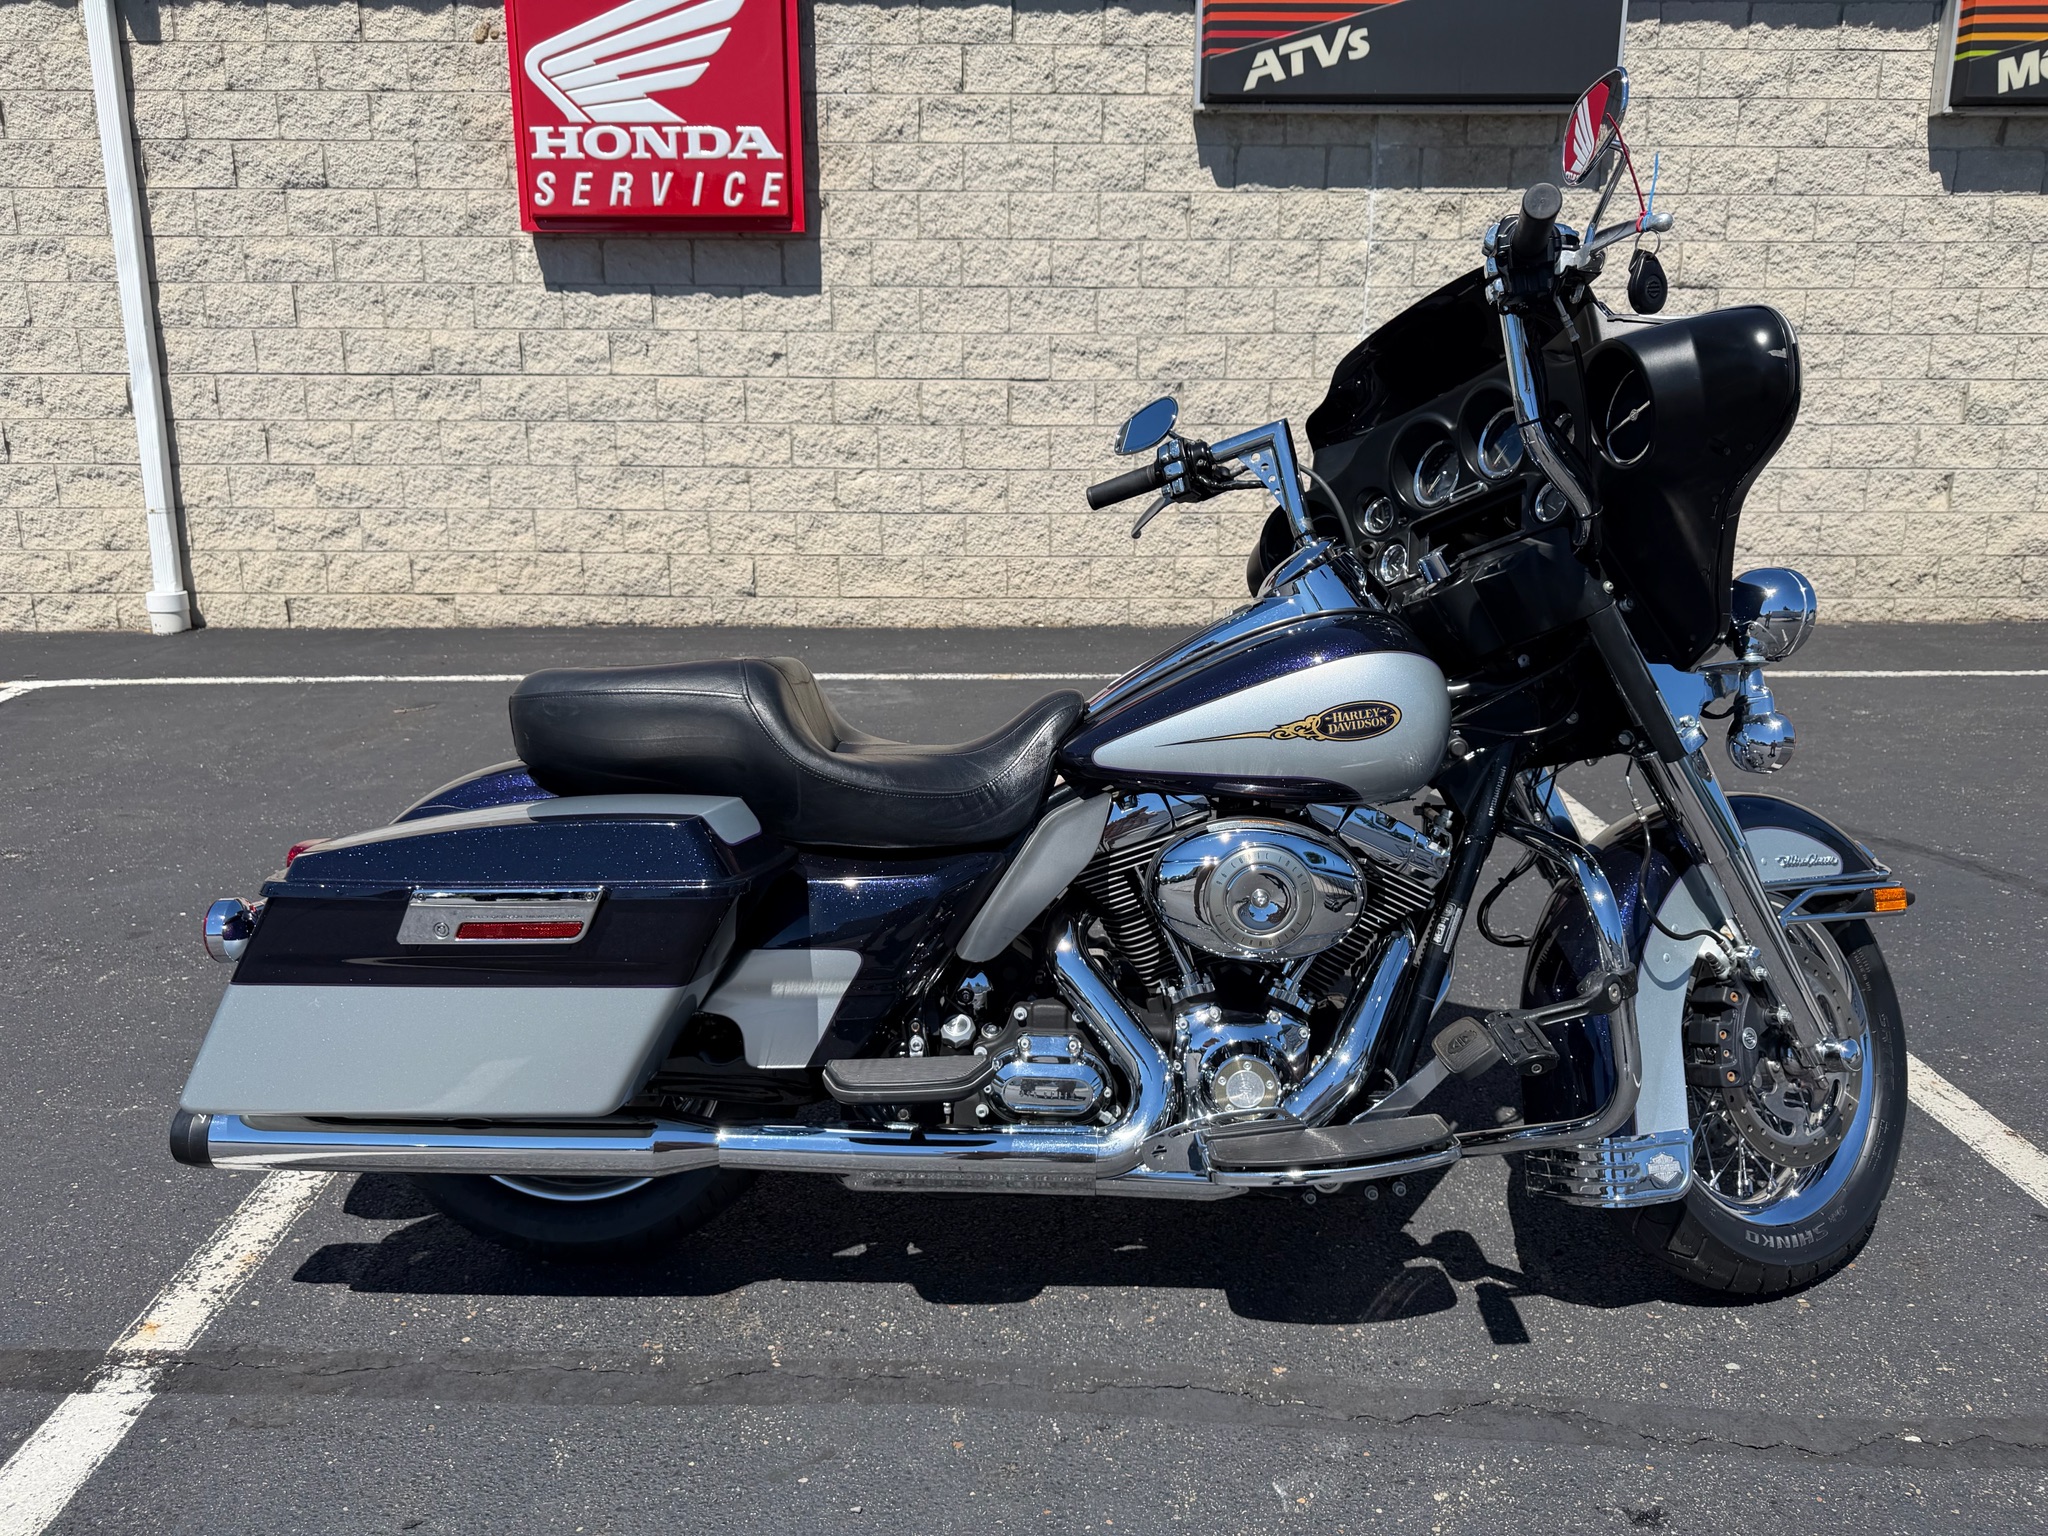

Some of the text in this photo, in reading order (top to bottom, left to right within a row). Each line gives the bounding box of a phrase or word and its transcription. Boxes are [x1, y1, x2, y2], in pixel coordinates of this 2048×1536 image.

[1243, 25, 1371, 92] ATVs
[529, 125, 784, 160] HONDA
[534, 171, 784, 207] SERVICE
[1328, 716, 1388, 735] DAVIDSON
[1332, 707, 1380, 723] HARLEY
[1745, 1222, 1830, 1250] SHINKO
